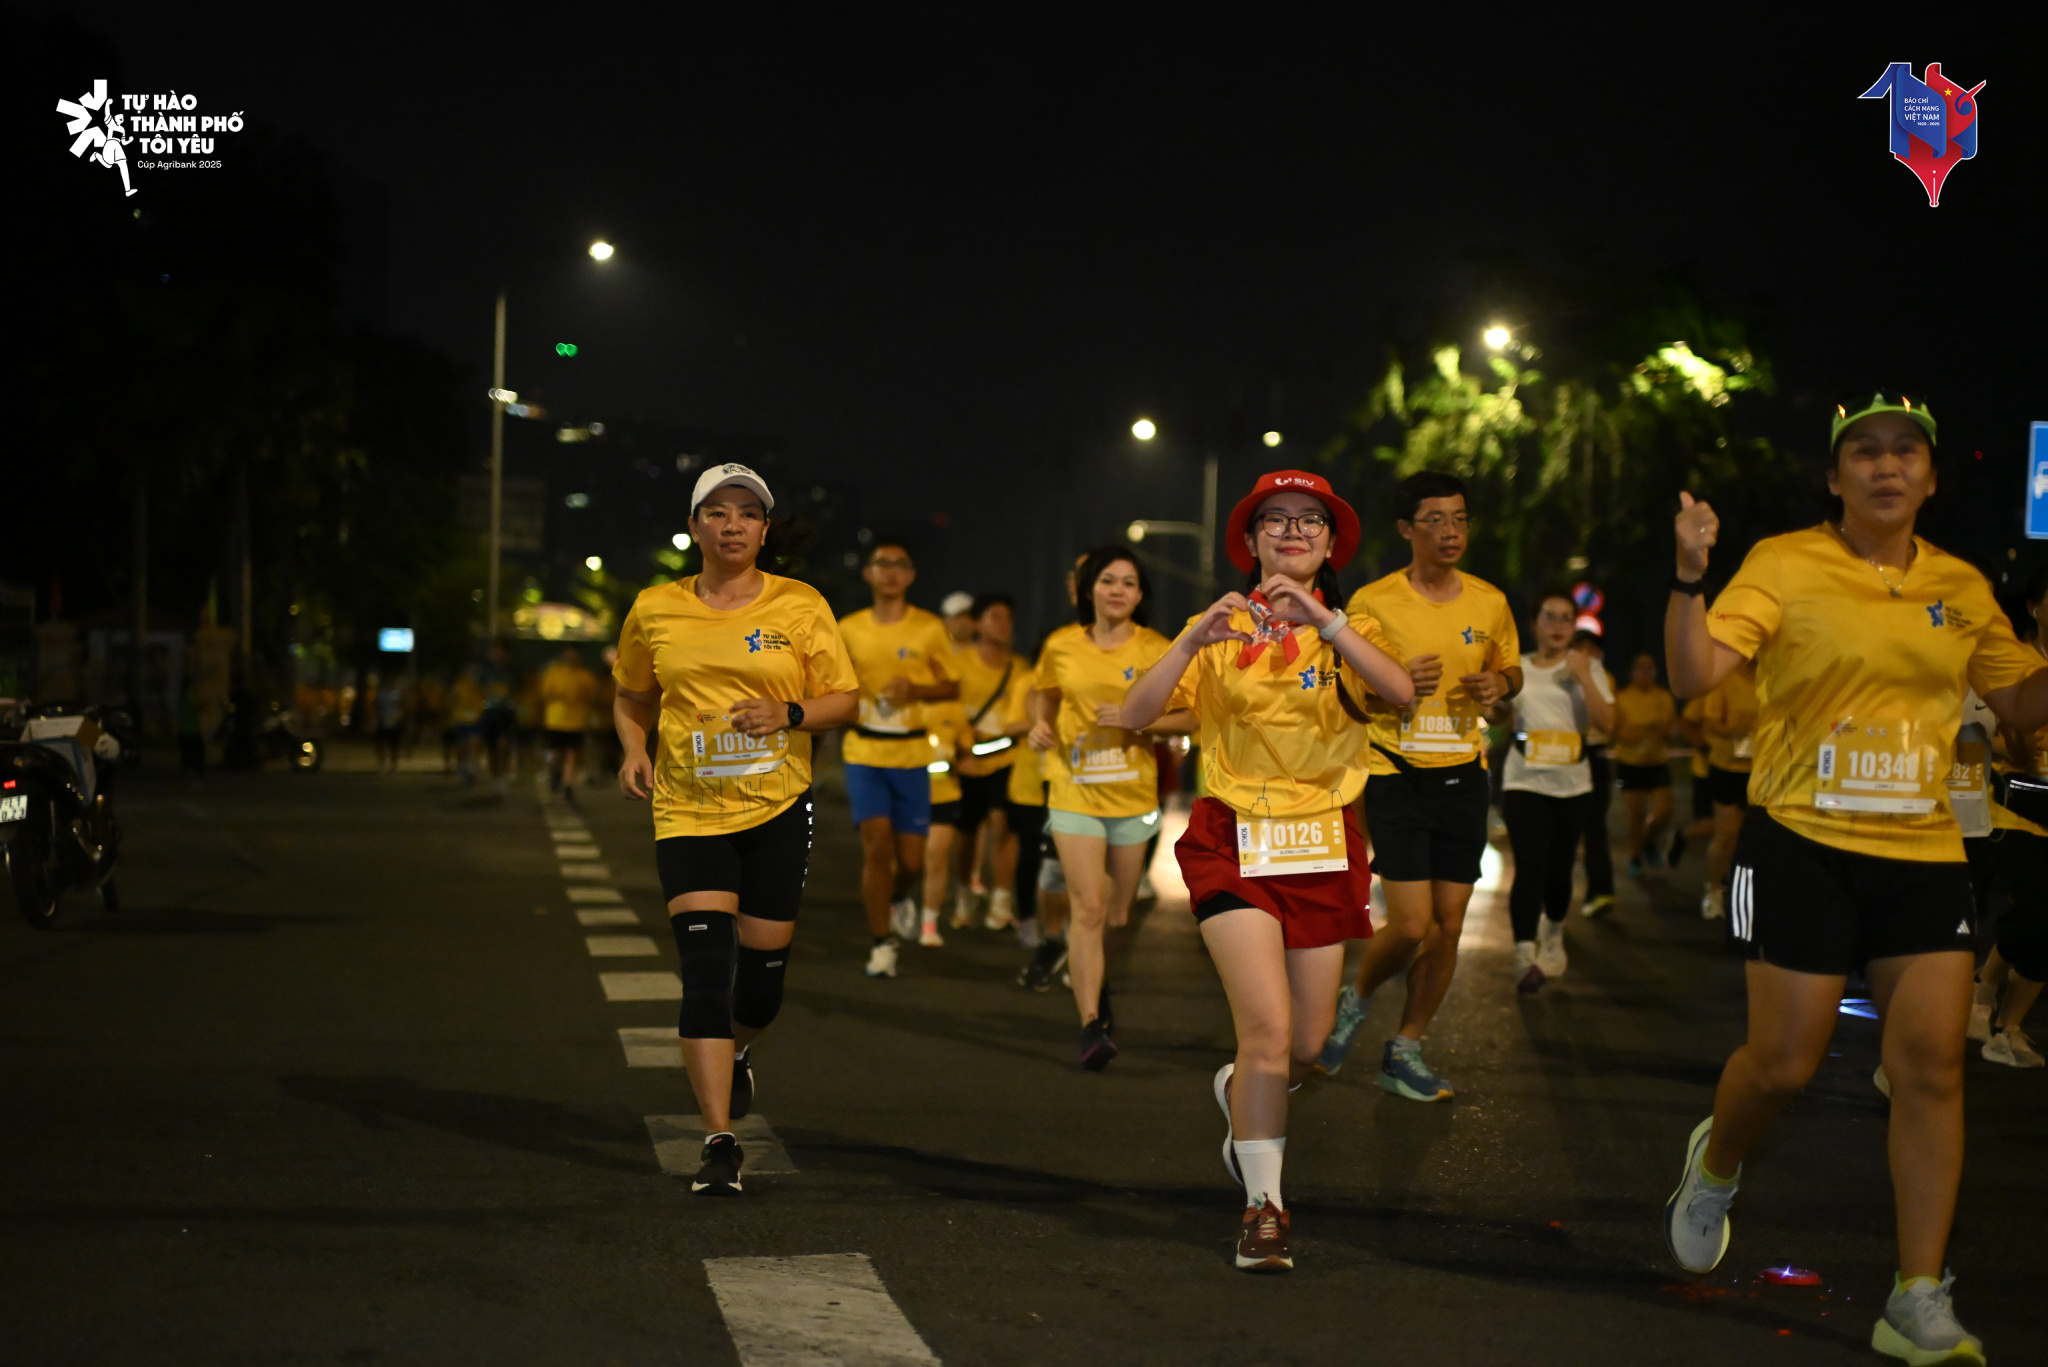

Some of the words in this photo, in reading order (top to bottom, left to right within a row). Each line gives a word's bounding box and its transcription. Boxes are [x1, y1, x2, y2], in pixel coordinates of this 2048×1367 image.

[1419, 714, 1460, 733] 10887
[695, 734, 703, 754] 10KM
[1823, 749, 1832, 775] 10KM
[1264, 821, 1323, 848] 10126
